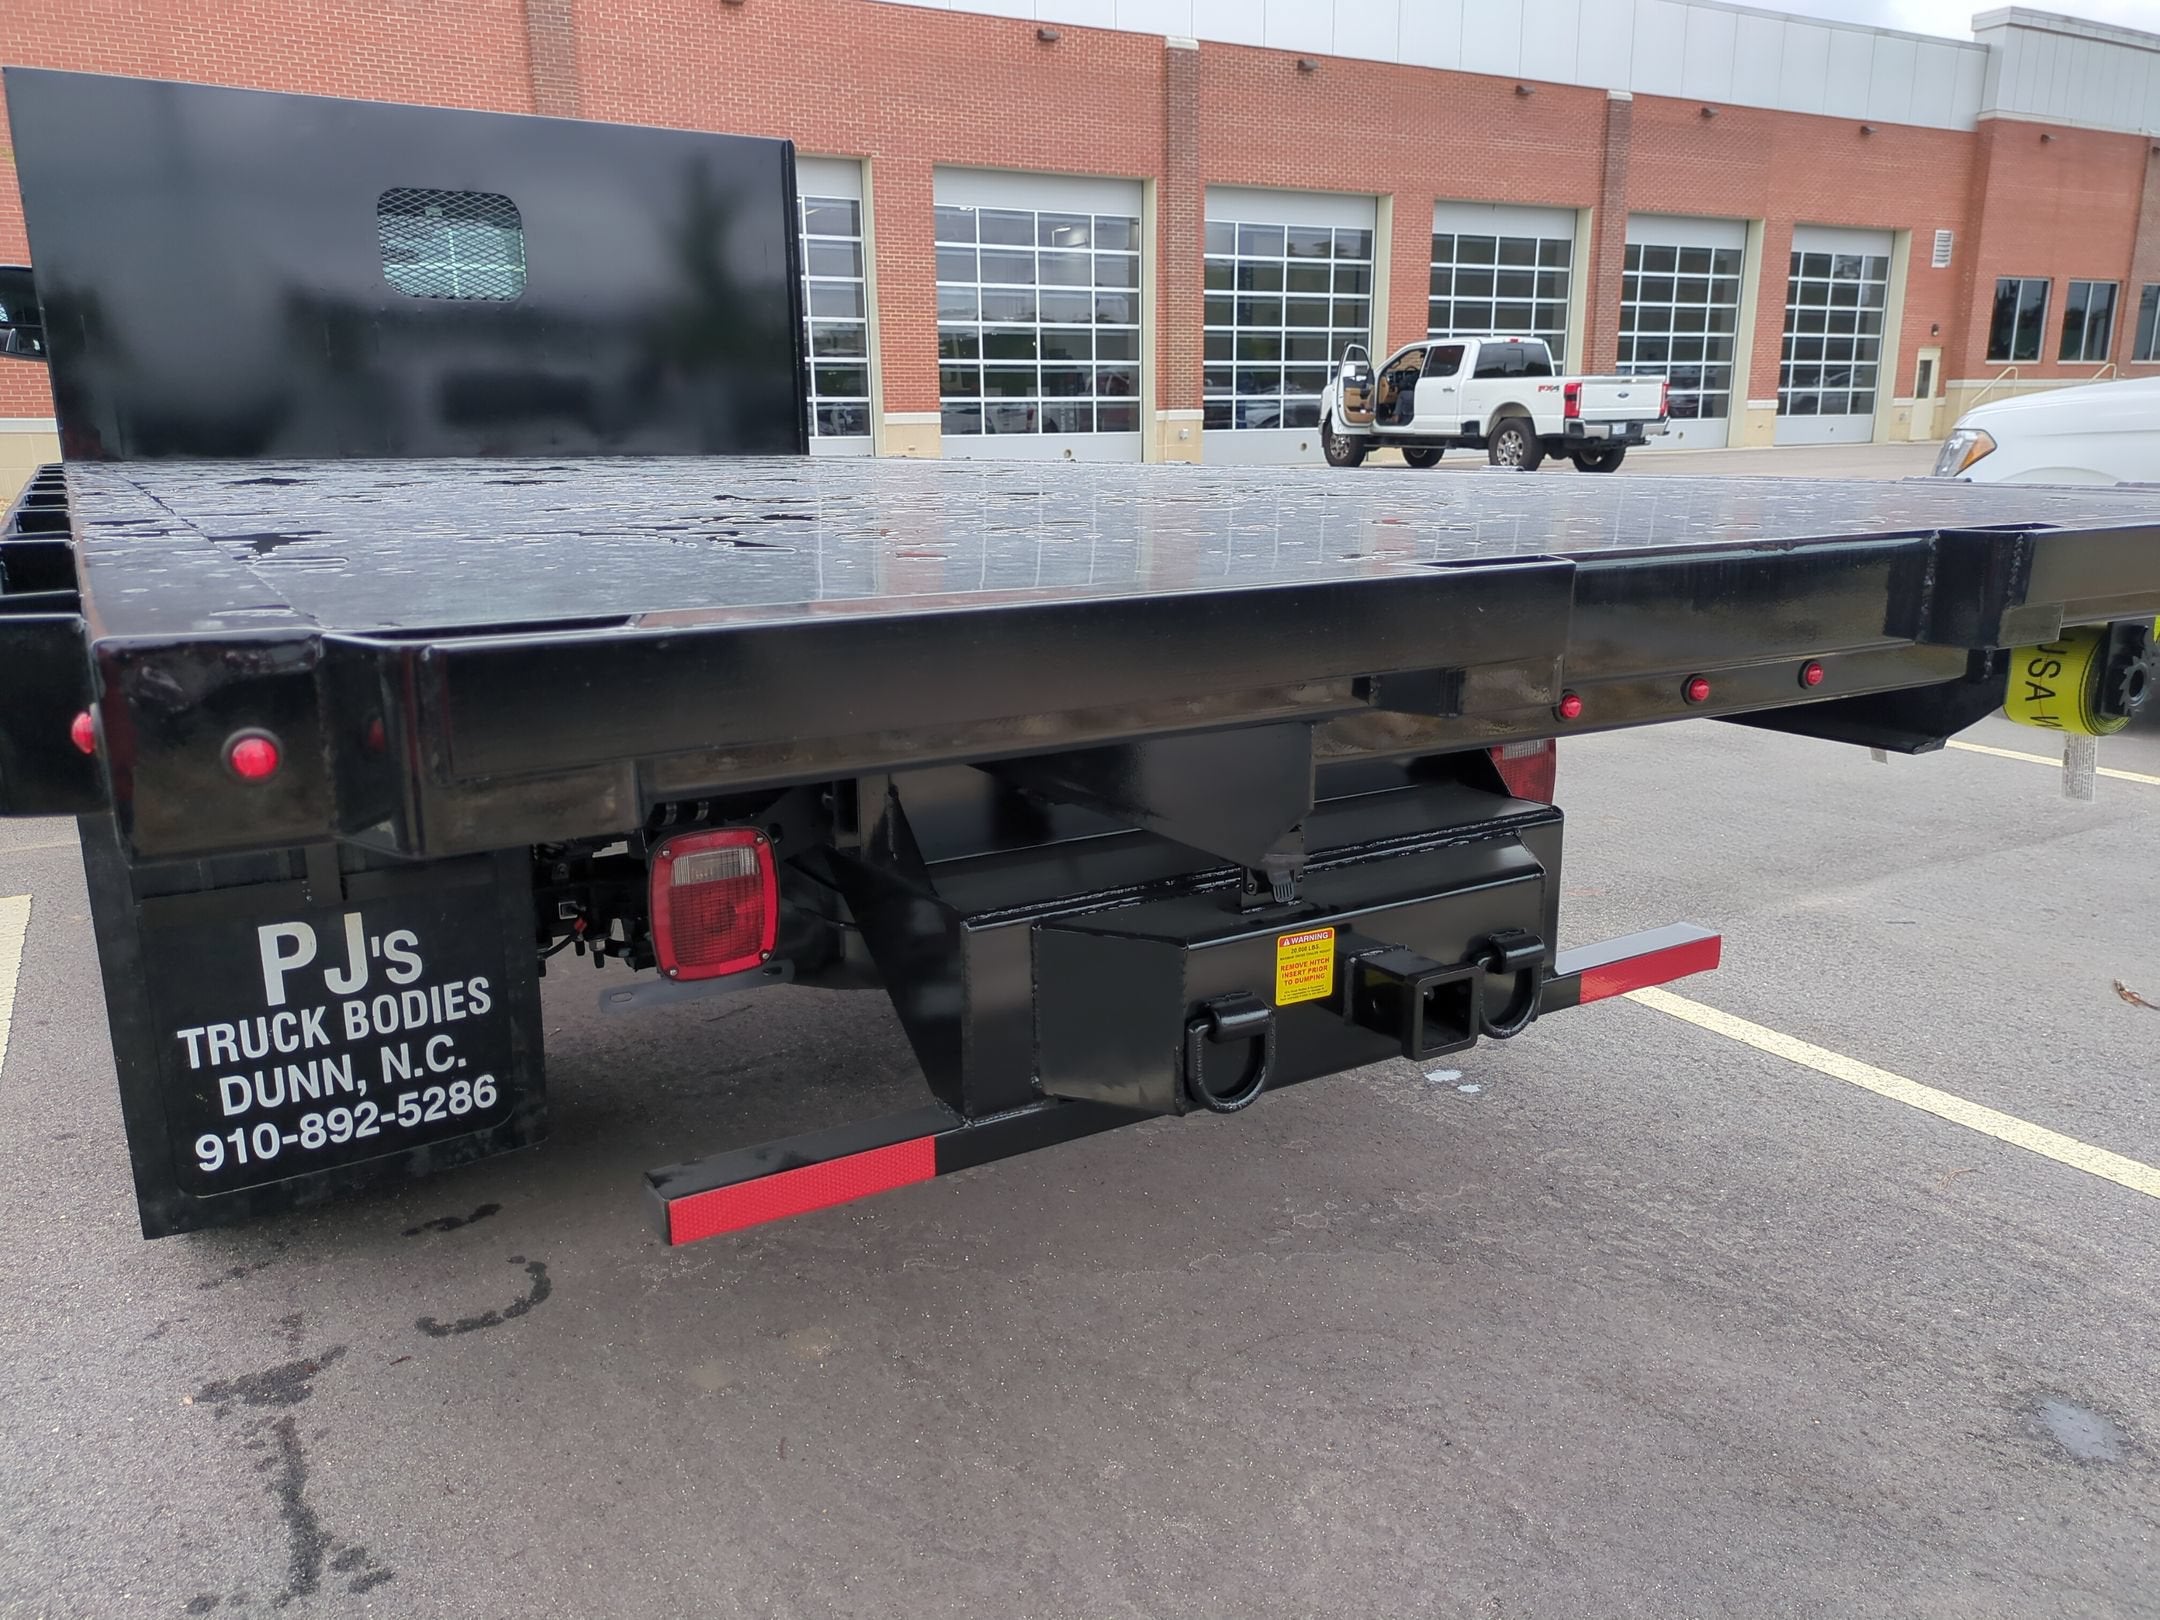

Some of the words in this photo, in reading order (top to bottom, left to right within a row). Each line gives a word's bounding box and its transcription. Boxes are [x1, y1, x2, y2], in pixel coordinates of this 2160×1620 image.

[1291, 932, 1329, 944] WARNING
[1281, 961, 1307, 971] REMOVE
[1309, 957, 1330, 966] HITCH
[1282, 969, 1306, 979] INSERT
[1308, 965, 1328, 974] PRIOR
[1294, 973, 1325, 984] DUMPING
[177, 1006, 330, 1069] TRUCK
[343, 977, 491, 1040] BODIES
[219, 1054, 367, 1116] DUNN,
[381, 1035, 466, 1083] N.C.
[195, 1074, 497, 1171] 910-892-5286
